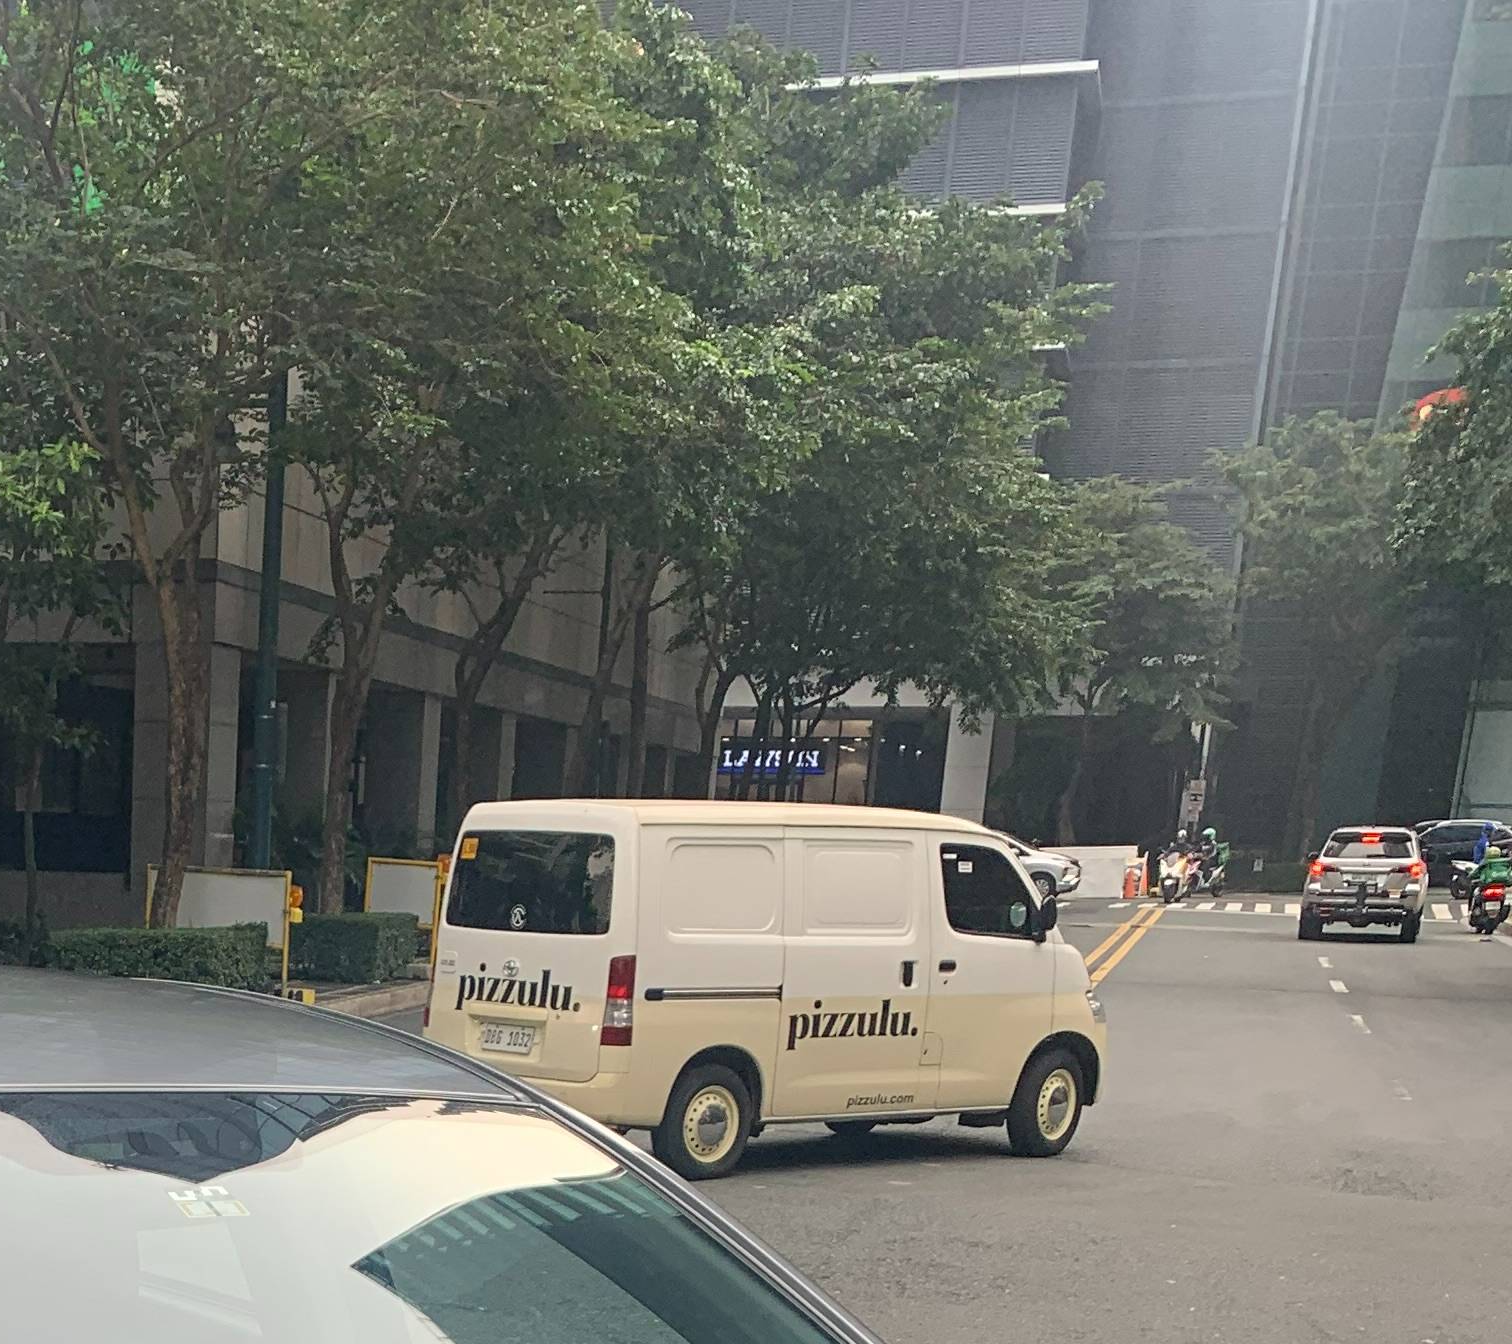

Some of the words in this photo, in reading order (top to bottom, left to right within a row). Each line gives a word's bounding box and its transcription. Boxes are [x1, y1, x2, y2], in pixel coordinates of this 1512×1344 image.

[454, 962, 581, 1012] pizzulu.
[786, 999, 919, 1051] pizzulu.
[846, 1093, 914, 1109] pizzulu.com
